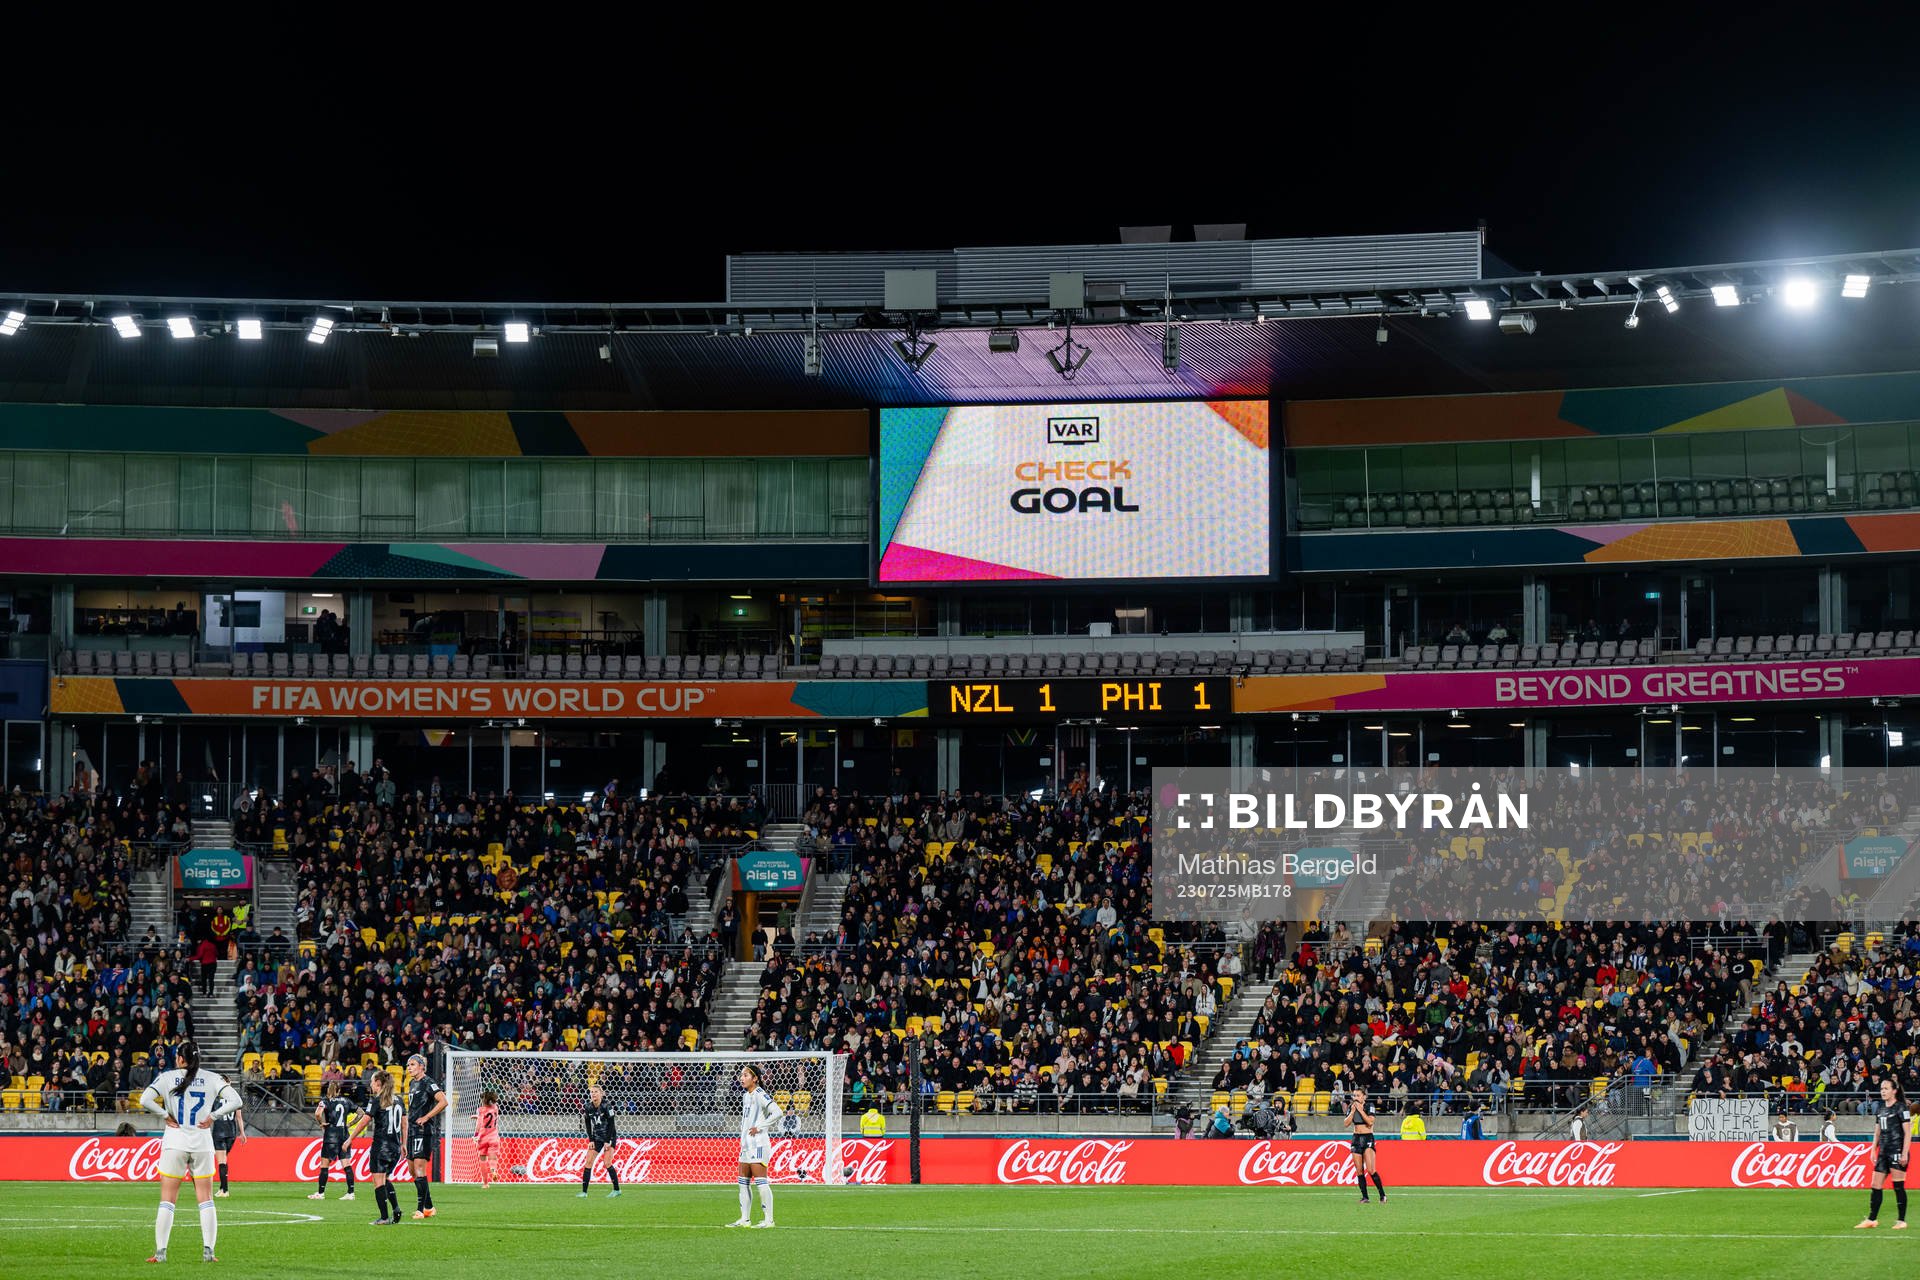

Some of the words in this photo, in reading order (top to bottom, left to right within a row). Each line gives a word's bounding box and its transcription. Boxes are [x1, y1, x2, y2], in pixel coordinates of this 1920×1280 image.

[1054, 423, 1093, 437] VAR
[1015, 460, 1132, 481] CHECK
[1010, 486, 1139, 514] GOAL
[252, 686, 322, 709] FIFA
[329, 687, 492, 711] WOMEN'S
[502, 688, 625, 711] WORLD
[951, 684, 1014, 712] NZL
[1039, 684, 1056, 712] 1
[1102, 683, 1162, 710] PHI
[1194, 682, 1211, 709] 1
[1495, 675, 1632, 702] BEYOND
[184, 868, 218, 878] Aisle
[221, 868, 241, 878] 20
[746, 870, 779, 880] Aisle
[782, 870, 797, 880] 19
[1853, 856, 1887, 867] Aisle
[178, 1092, 206, 1126] 17
[335, 1103, 345, 1127] 2
[386, 1104, 403, 1134] 10
[1695, 1115, 1715, 1130] ON
[1722, 1115, 1760, 1130] FIRE
[414, 1138, 424, 1151] 17
[69, 1137, 188, 1181] Coca-Co
[527, 1138, 660, 1182] CocaCola
[998, 1139, 1134, 1184] Coca-Cola
[1482, 1140, 1624, 1186] Coca-Cola
[1731, 1142, 1873, 1188] Coca-Cola
